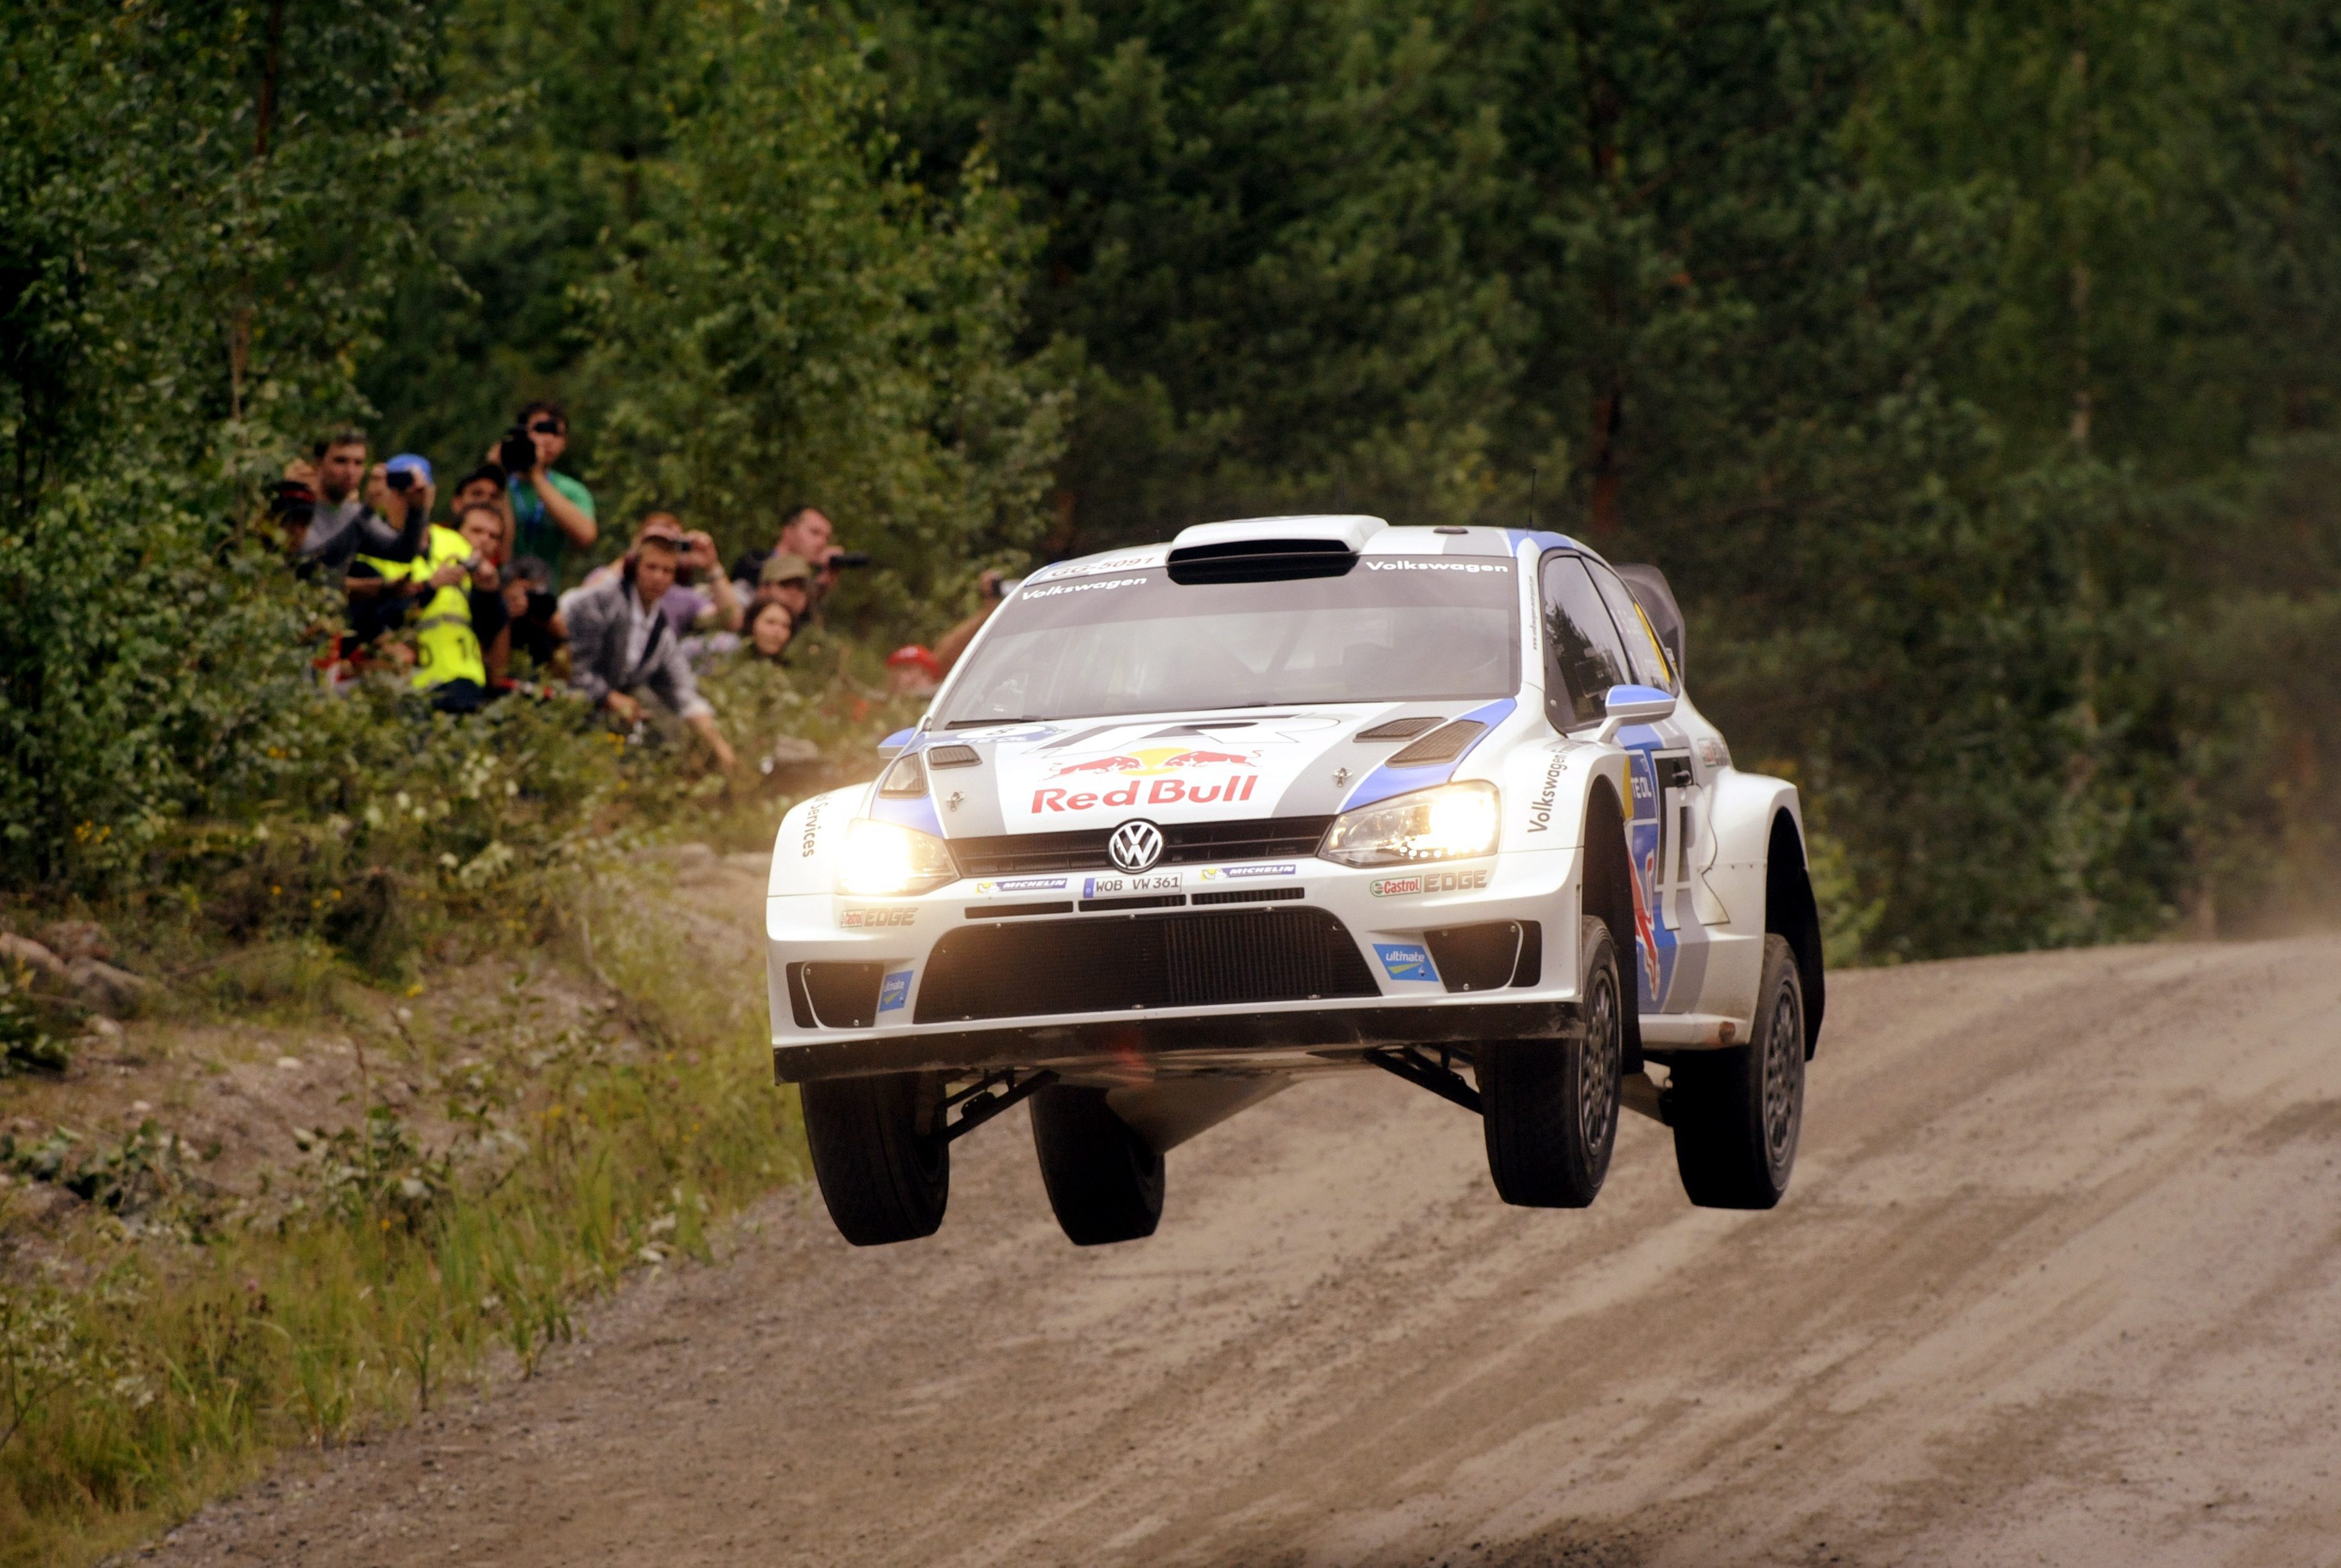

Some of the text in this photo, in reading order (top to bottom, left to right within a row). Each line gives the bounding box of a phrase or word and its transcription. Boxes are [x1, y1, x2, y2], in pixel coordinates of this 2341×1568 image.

[1365, 560, 1508, 573] Volkswagen
[1023, 578, 1147, 600] Volkswagen
[1031, 775, 1259, 814] Red Bull
[1527, 754, 1568, 833] Volkswagen
[802, 802, 829, 858] Services
[1230, 866, 1295, 874] MICHELIN
[1002, 879, 1066, 889] MICHELIN
[1096, 880, 1123, 892] WOB
[1133, 879, 1150, 890] VW
[1153, 877, 1180, 889] 361
[1383, 870, 1487, 894] Castrol EDGE
[864, 908, 919, 926] EDGE
[1385, 951, 1425, 963] ultimate
